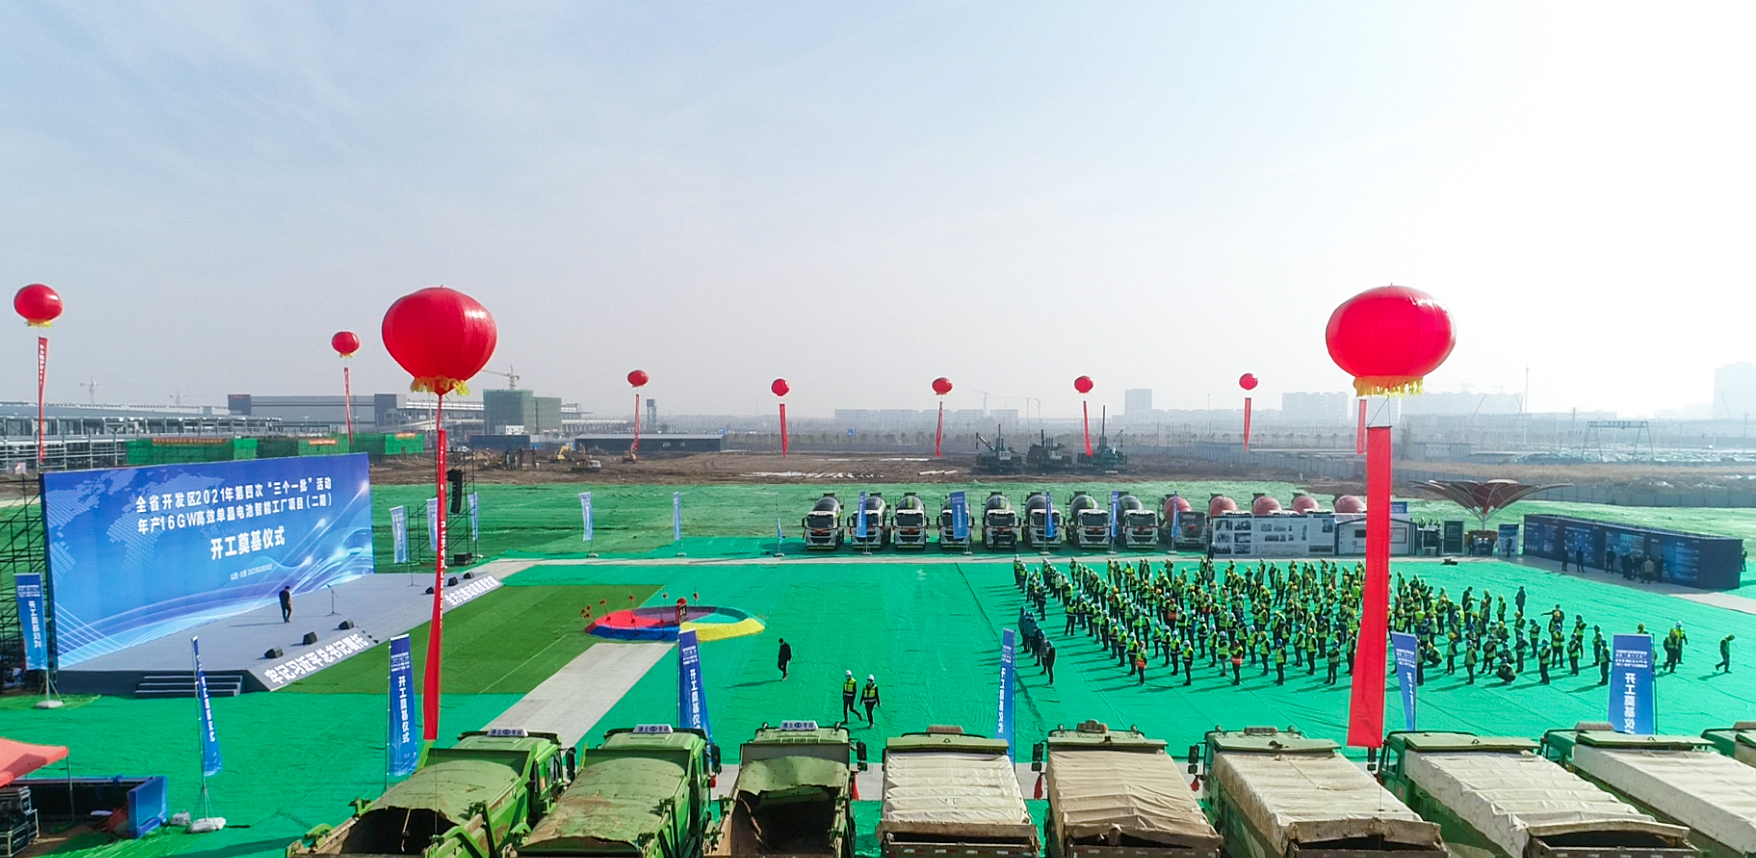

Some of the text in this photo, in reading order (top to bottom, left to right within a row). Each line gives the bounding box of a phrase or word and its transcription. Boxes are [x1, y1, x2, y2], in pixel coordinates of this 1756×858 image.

[210, 525, 285, 560] 开工奠基仪式
[397, 675, 410, 744] 开工奠基仪式
